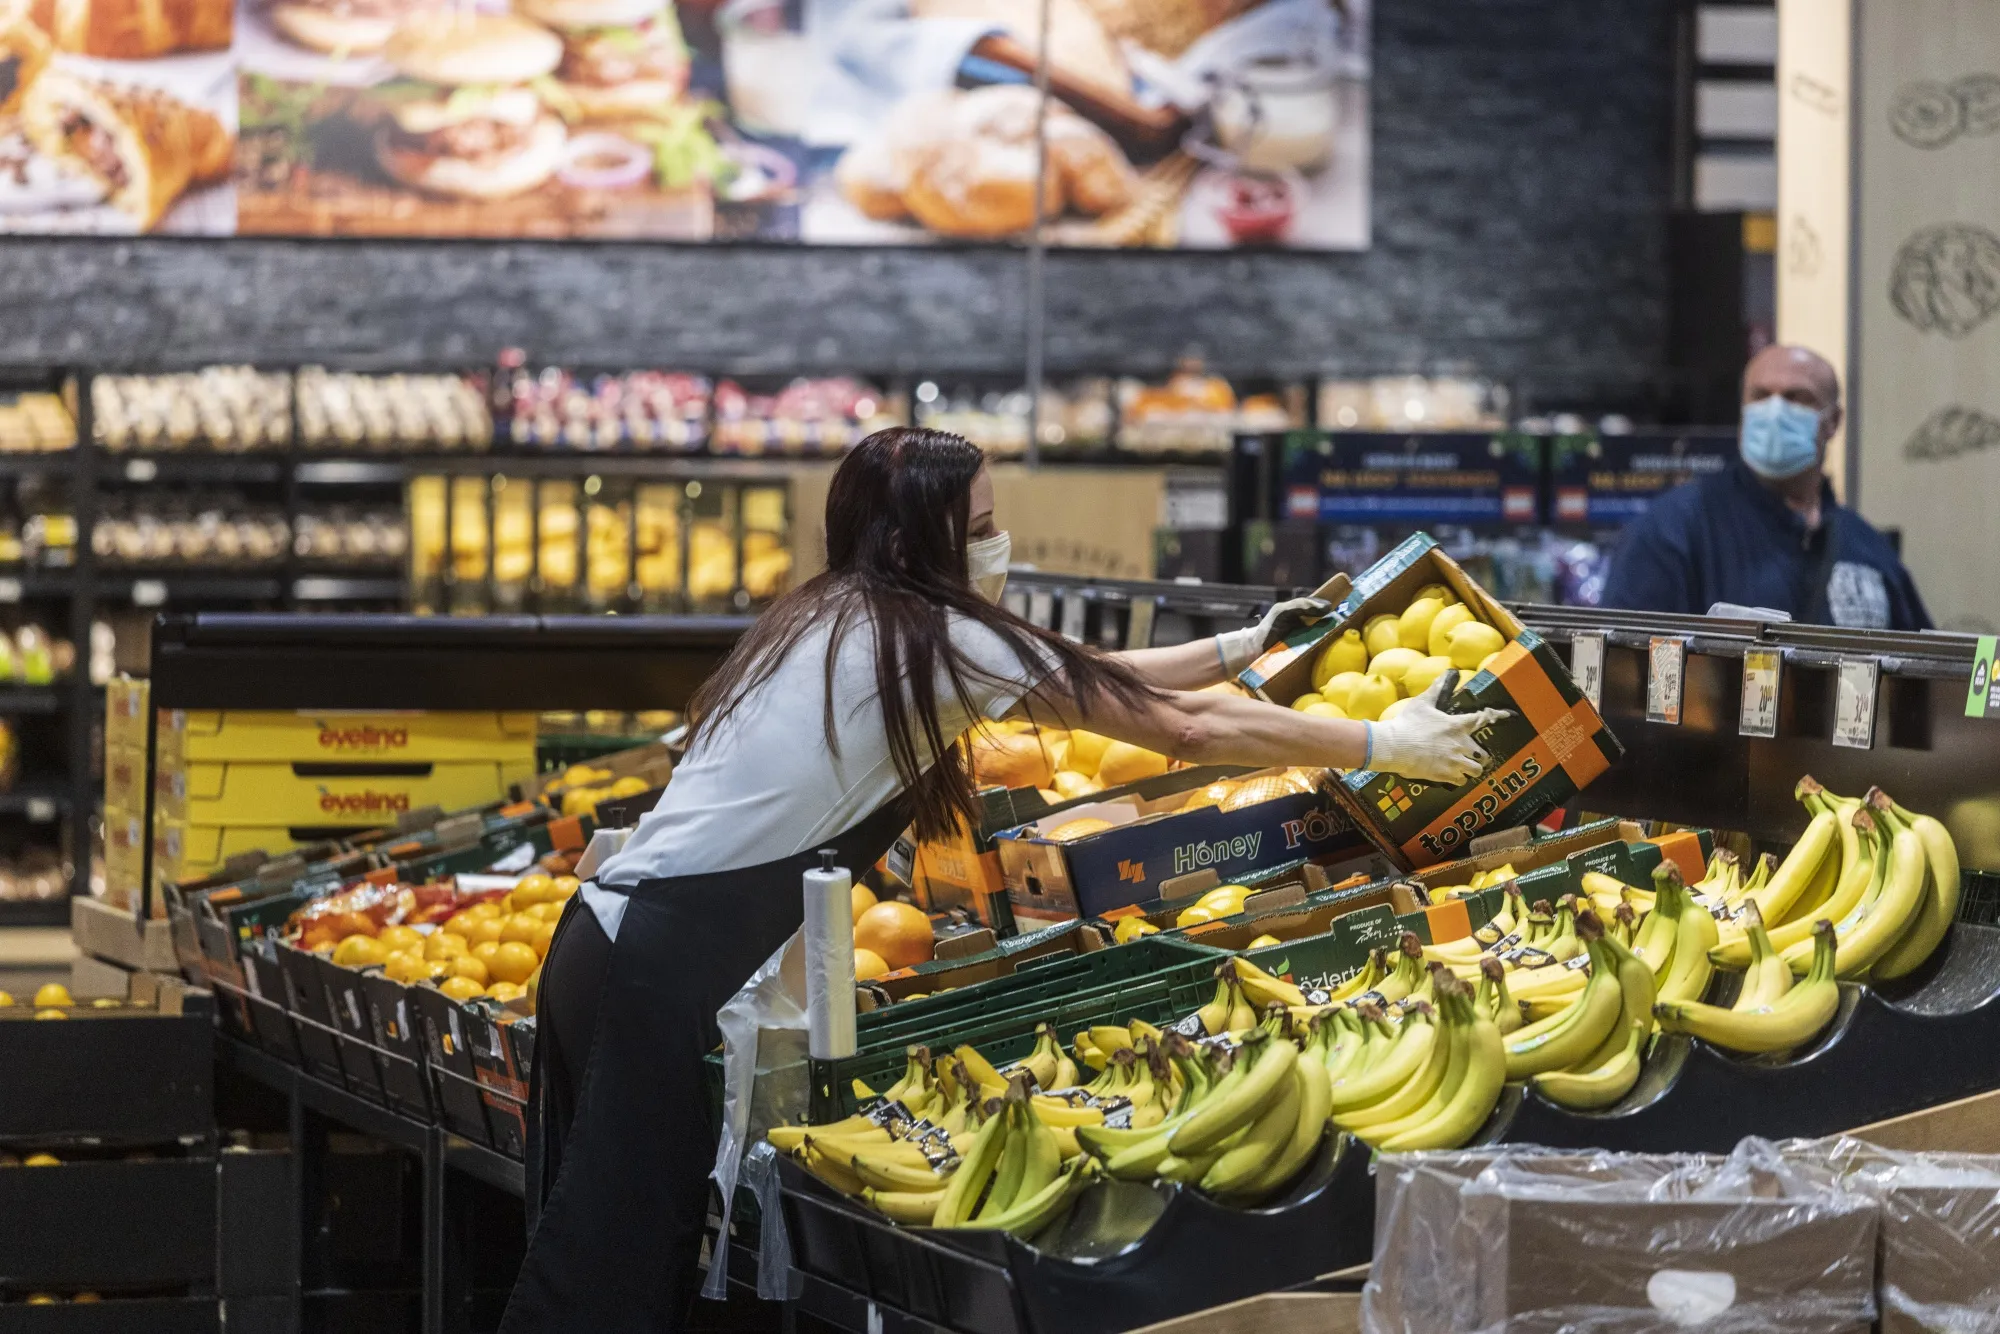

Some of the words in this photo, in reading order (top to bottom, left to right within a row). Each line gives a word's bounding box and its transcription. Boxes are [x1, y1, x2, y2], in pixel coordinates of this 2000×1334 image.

[1418, 756, 1542, 857] toppins
[1174, 831, 1262, 874] Honey
[1280, 806, 1356, 850] POM
[1585, 855, 1609, 867] PRODUCE
[1350, 920, 1375, 931] PRODUCE
[1375, 917, 1382, 925] OF
